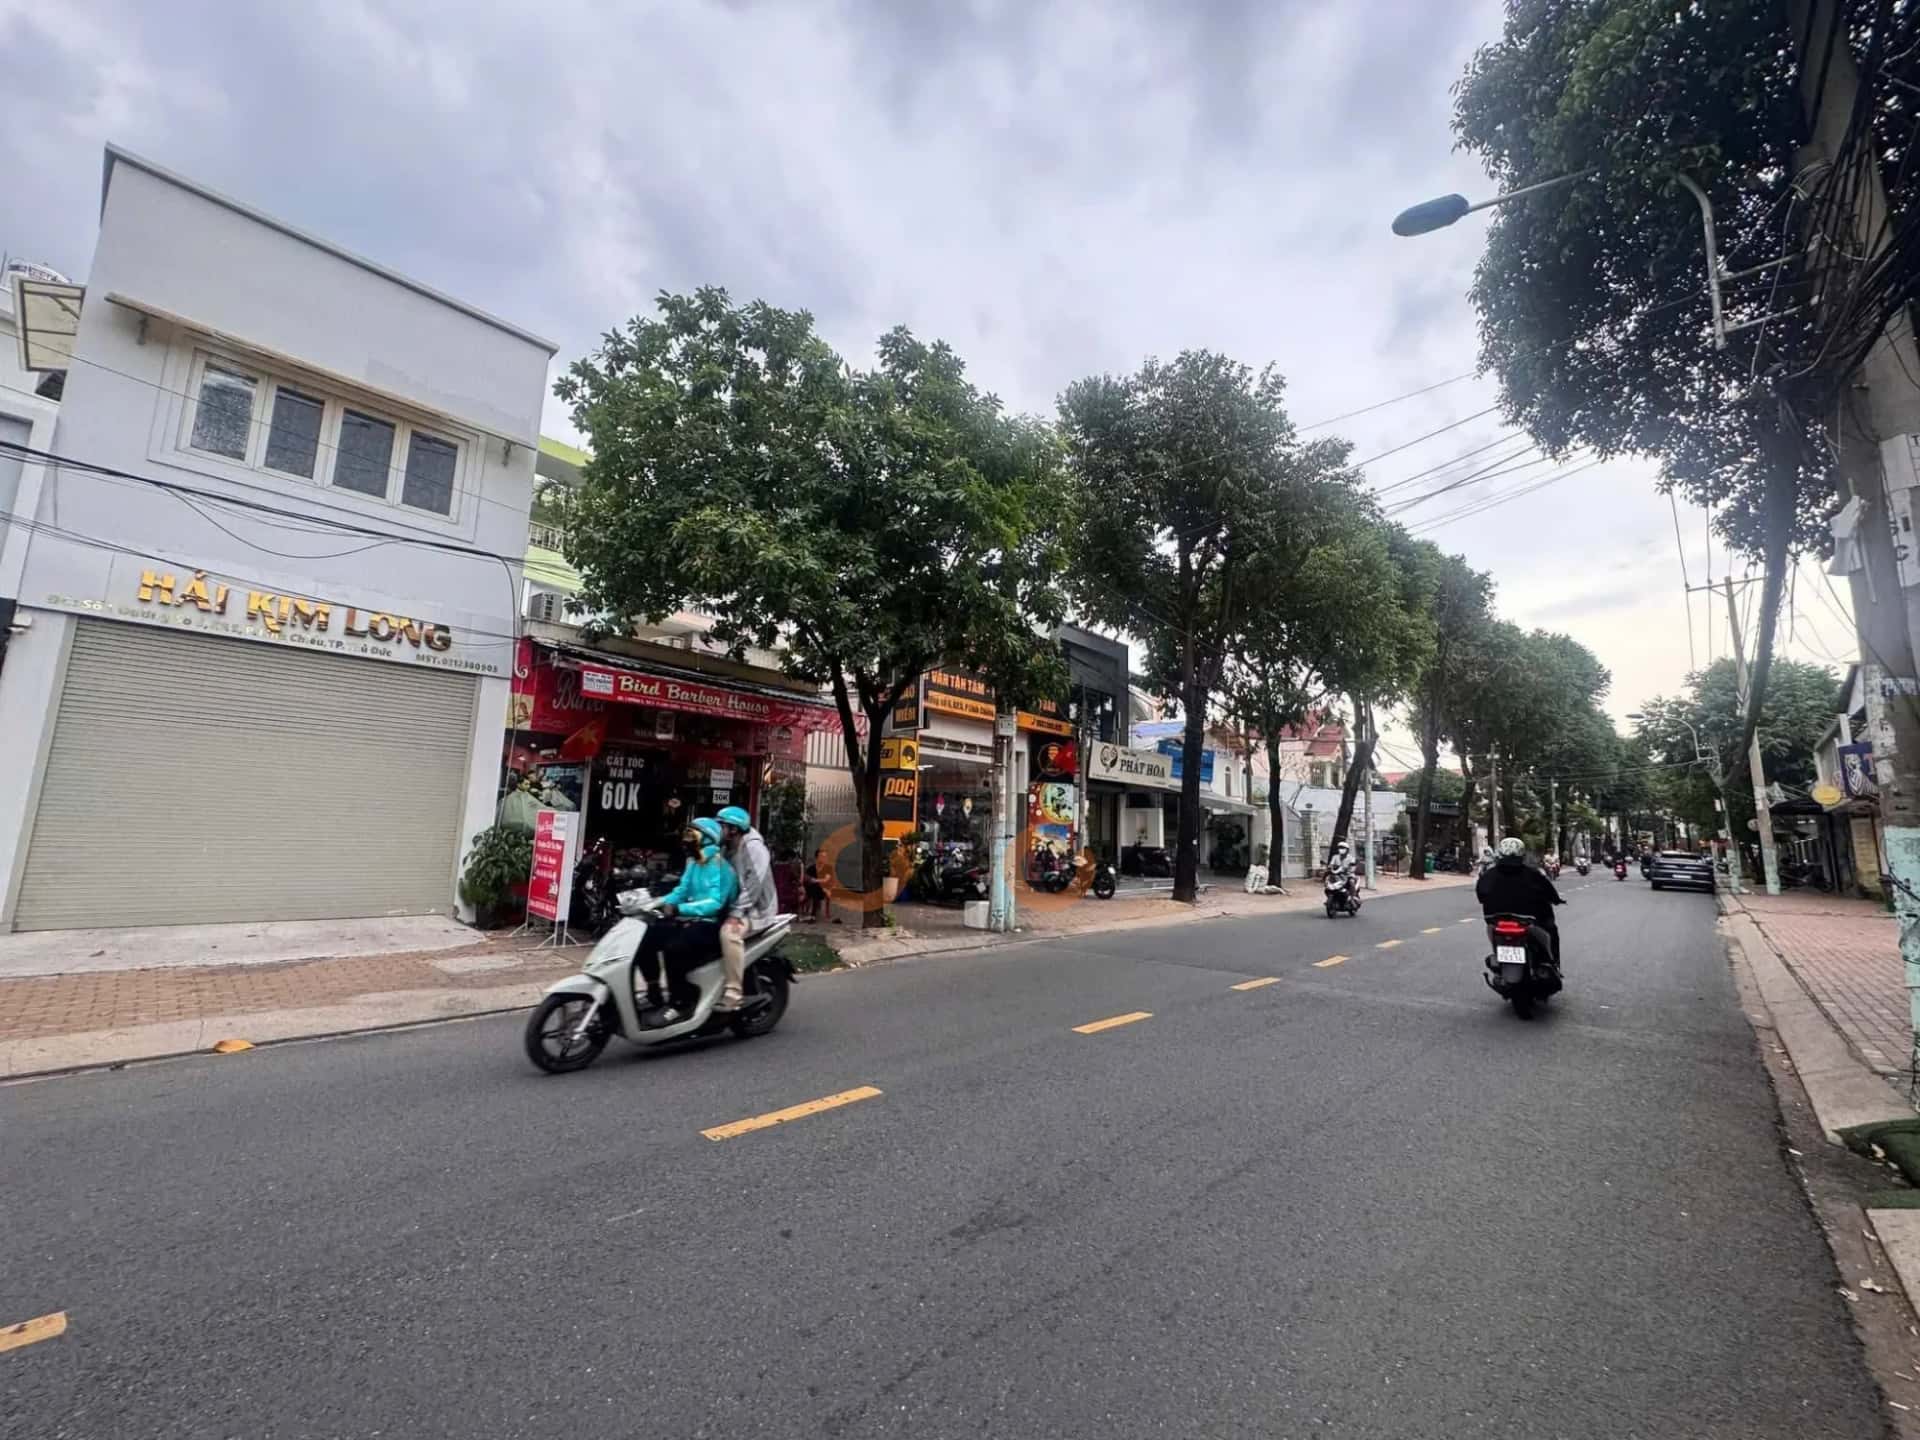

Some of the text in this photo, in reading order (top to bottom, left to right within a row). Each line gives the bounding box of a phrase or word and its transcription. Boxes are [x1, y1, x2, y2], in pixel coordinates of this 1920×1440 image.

[247, 591, 330, 633] KIM
[344, 607, 452, 651] LONG
[618, 675, 662, 697] Bird
[667, 682, 721, 706] Barber
[727, 692, 770, 715] House
[1120, 757, 1146, 775] PHÁT
[601, 781, 641, 811] 60K
